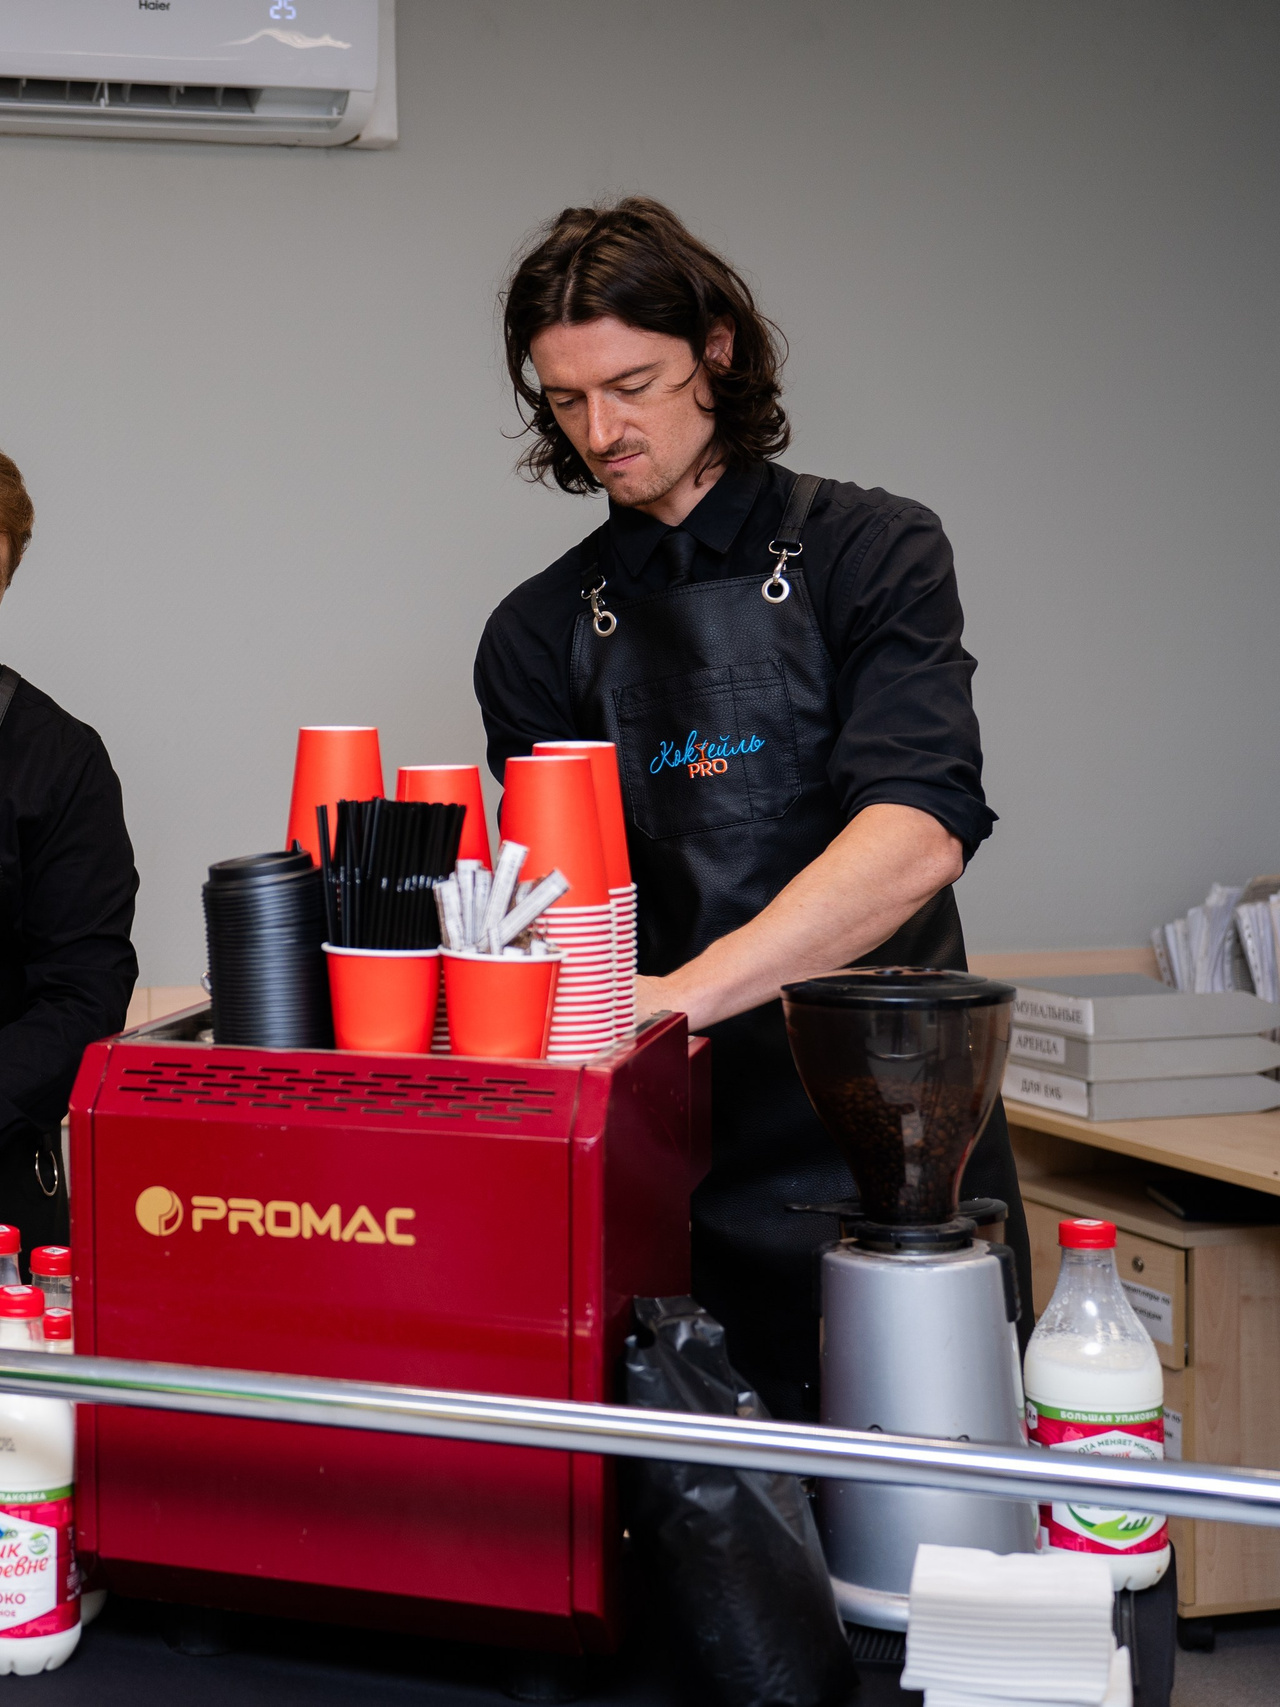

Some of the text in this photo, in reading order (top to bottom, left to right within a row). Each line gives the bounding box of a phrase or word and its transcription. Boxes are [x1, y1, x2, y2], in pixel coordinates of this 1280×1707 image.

[138, 0, 170, 11] Haier
[269, 0, 297, 20] 25
[687, 758, 728, 779] PRO
[1015, 1034, 1059, 1055] АРЕНДА
[1021, 1078, 1041, 1094] ДЛЯ
[191, 1195, 416, 1247] PROMAC
[1060, 1410, 1113, 1423] БОЛЬШАЯ
[1114, 1411, 1159, 1423] УПАКОВКА
[1097, 1438, 1133, 1447] МЕНЯЕТ
